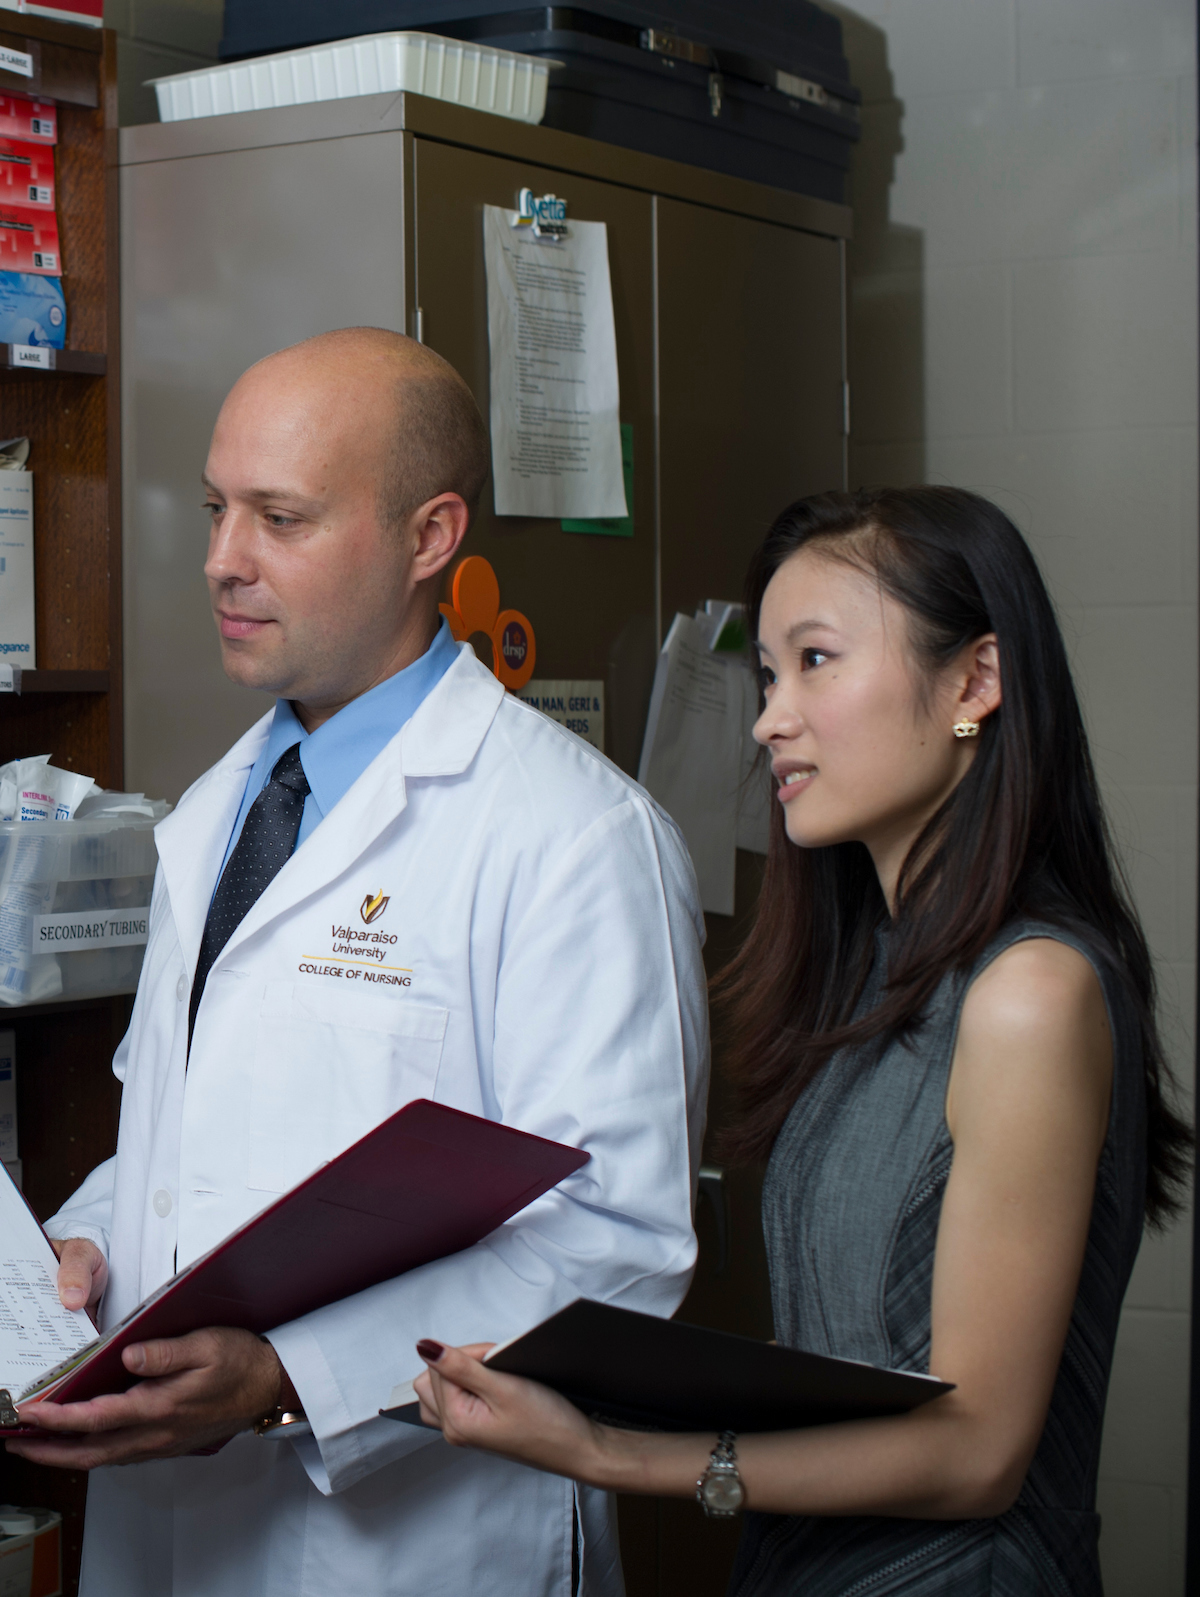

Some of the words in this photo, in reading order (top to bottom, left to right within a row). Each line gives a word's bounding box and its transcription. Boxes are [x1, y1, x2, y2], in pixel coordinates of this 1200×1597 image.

[19, 352, 41, 362] LARGE
[503, 632, 525, 660] drsp
[542, 697, 567, 714] MAN,
[569, 697, 591, 711] GERI
[593, 697, 600, 711] &
[566, 718, 589, 733] PEDS
[21, 806, 49, 818] Secondary
[40, 920, 108, 941] SECONDARY
[110, 919, 146, 937] TUBING
[331, 925, 398, 945] Valparaiso
[332, 942, 386, 962] University
[298, 963, 344, 978] COLLEGE
[345, 969, 361, 979] OF
[363, 971, 412, 987] NURSING
